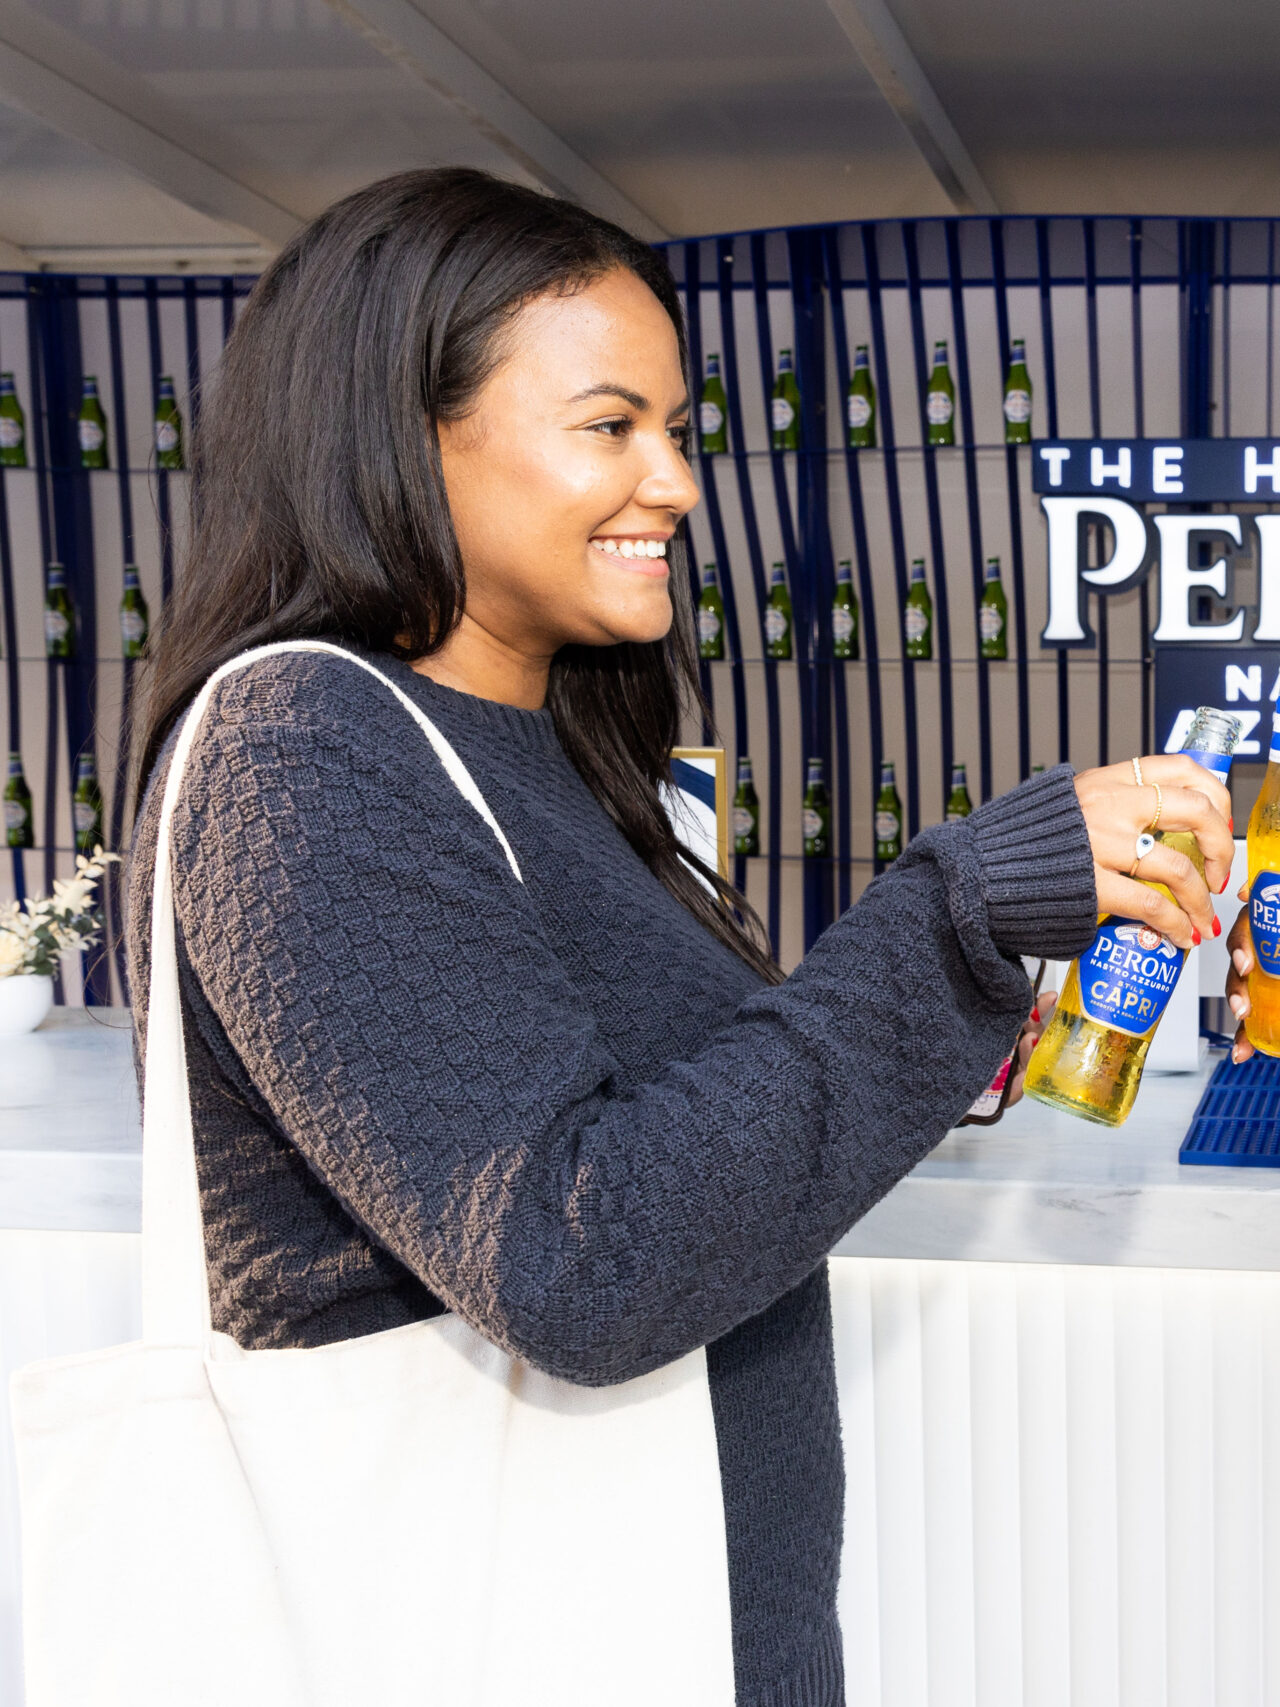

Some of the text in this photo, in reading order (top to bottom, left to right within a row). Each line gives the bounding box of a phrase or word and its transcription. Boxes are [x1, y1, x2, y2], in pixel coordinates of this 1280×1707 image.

[1040, 446, 1184, 494] THE
[1089, 958, 1170, 993] NASTRO AZZURRO
[1093, 935, 1178, 985] PERONI
[1091, 980, 1158, 1019] CAPRI
